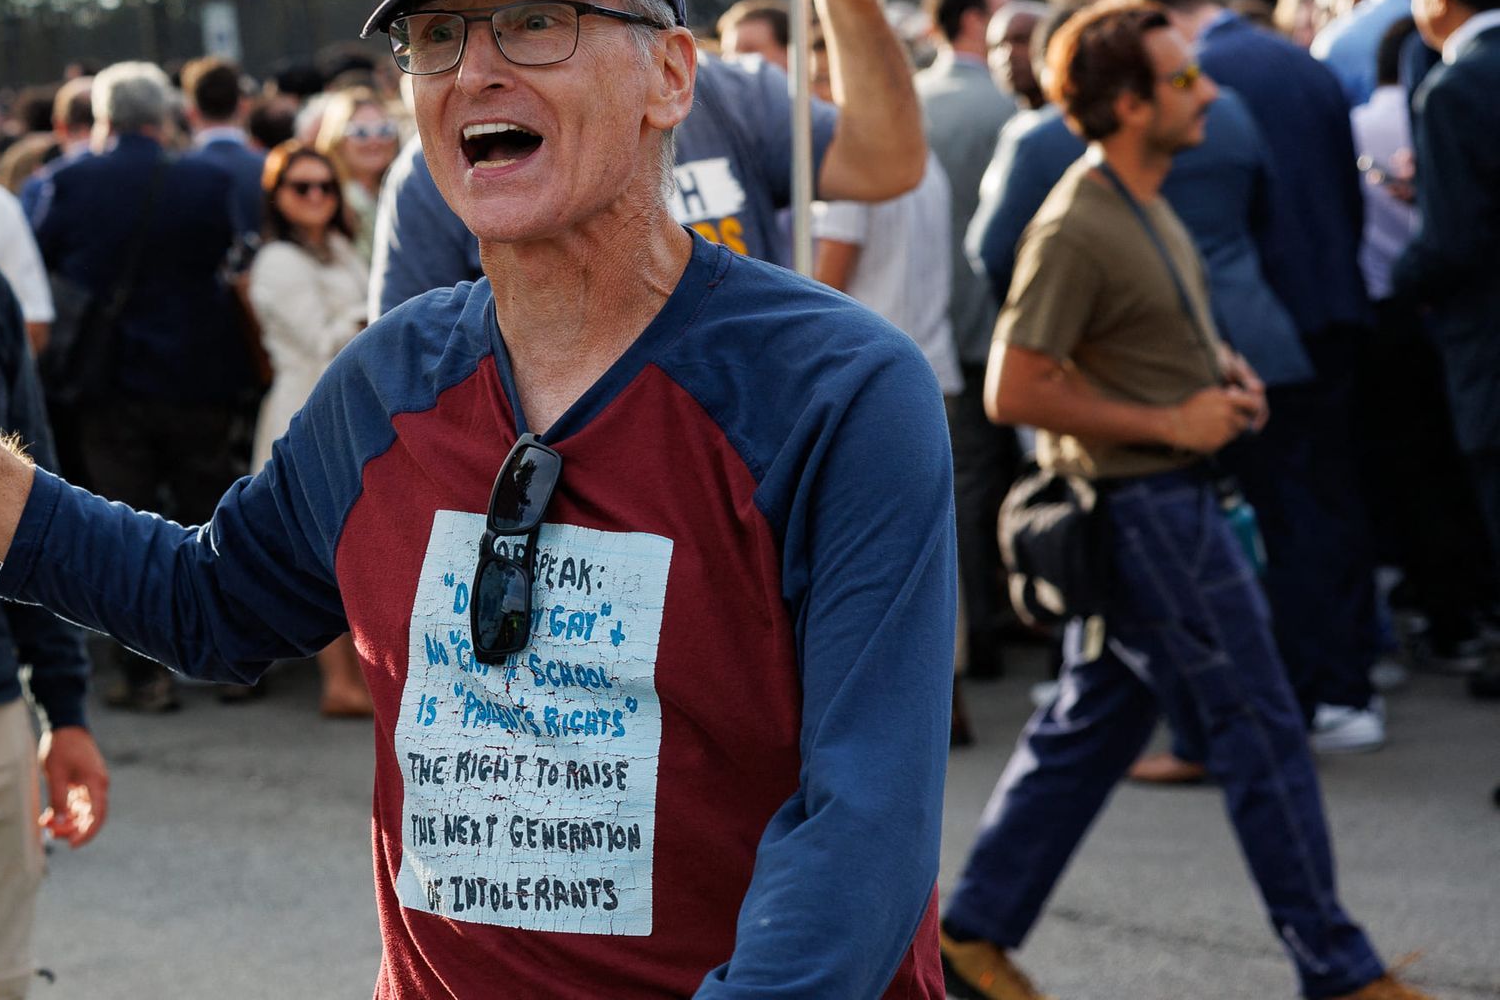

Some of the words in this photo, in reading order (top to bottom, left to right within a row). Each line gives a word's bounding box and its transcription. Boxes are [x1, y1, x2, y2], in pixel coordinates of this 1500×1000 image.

[425, 632, 449, 666] NO
[529, 653, 613, 689] SCHOOL
[417, 694, 438, 726] IS
[407, 752, 448, 785] THE
[455, 751, 528, 784] RIGHT
[536, 757, 560, 788] TO
[566, 760, 629, 791] RAISE
[411, 814, 436, 846] THE
[444, 814, 498, 848] NEXT
[509, 815, 641, 853] GENERATION
[450, 876, 619, 912] INTOLERANTS
